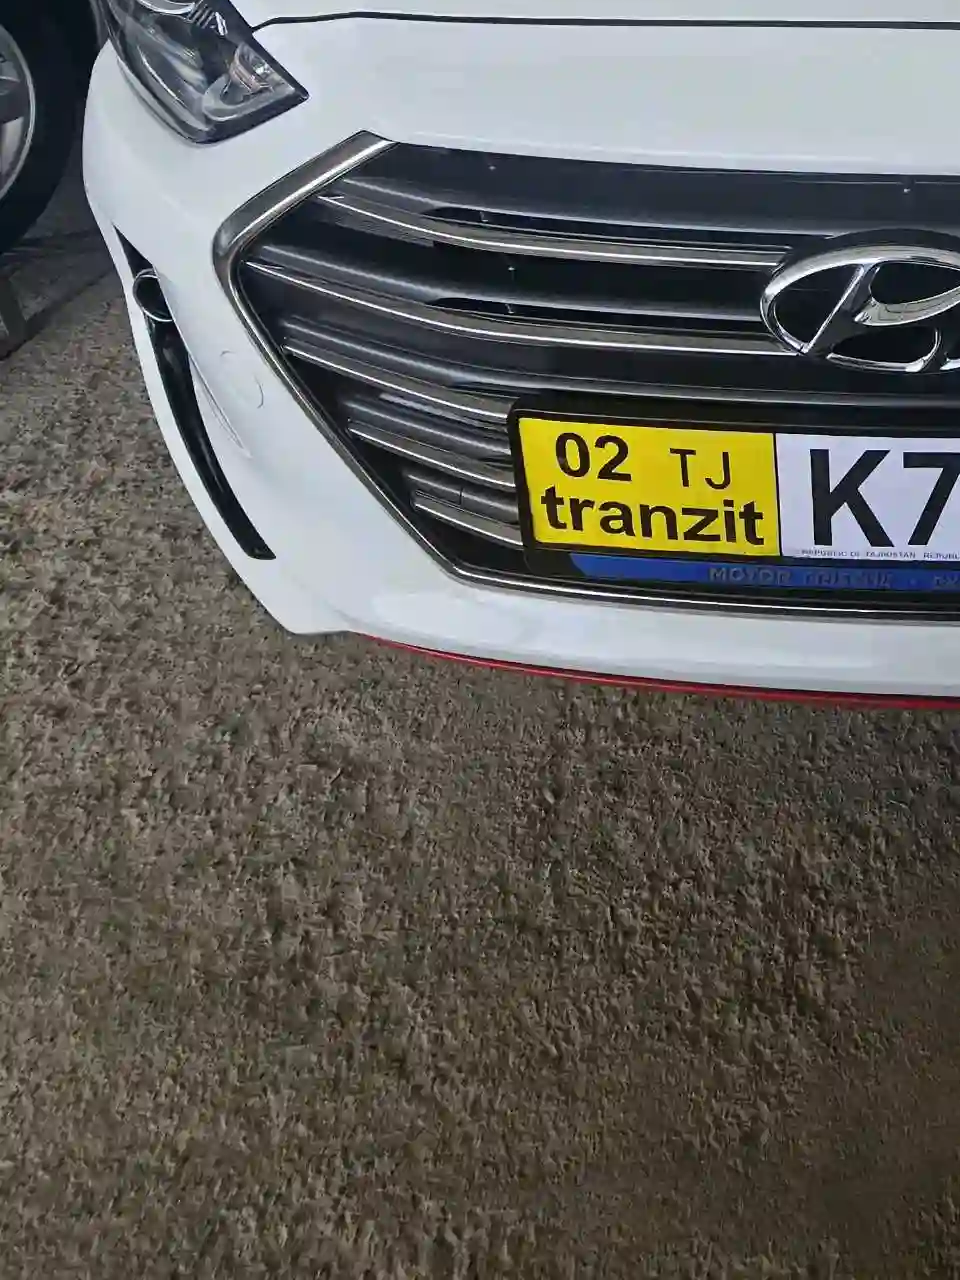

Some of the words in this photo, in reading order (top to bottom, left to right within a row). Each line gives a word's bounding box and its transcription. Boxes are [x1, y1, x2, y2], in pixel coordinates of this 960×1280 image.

[555, 432, 632, 482] 02
[670, 448, 732, 490] TJ
[541, 485, 764, 546] tranzit
